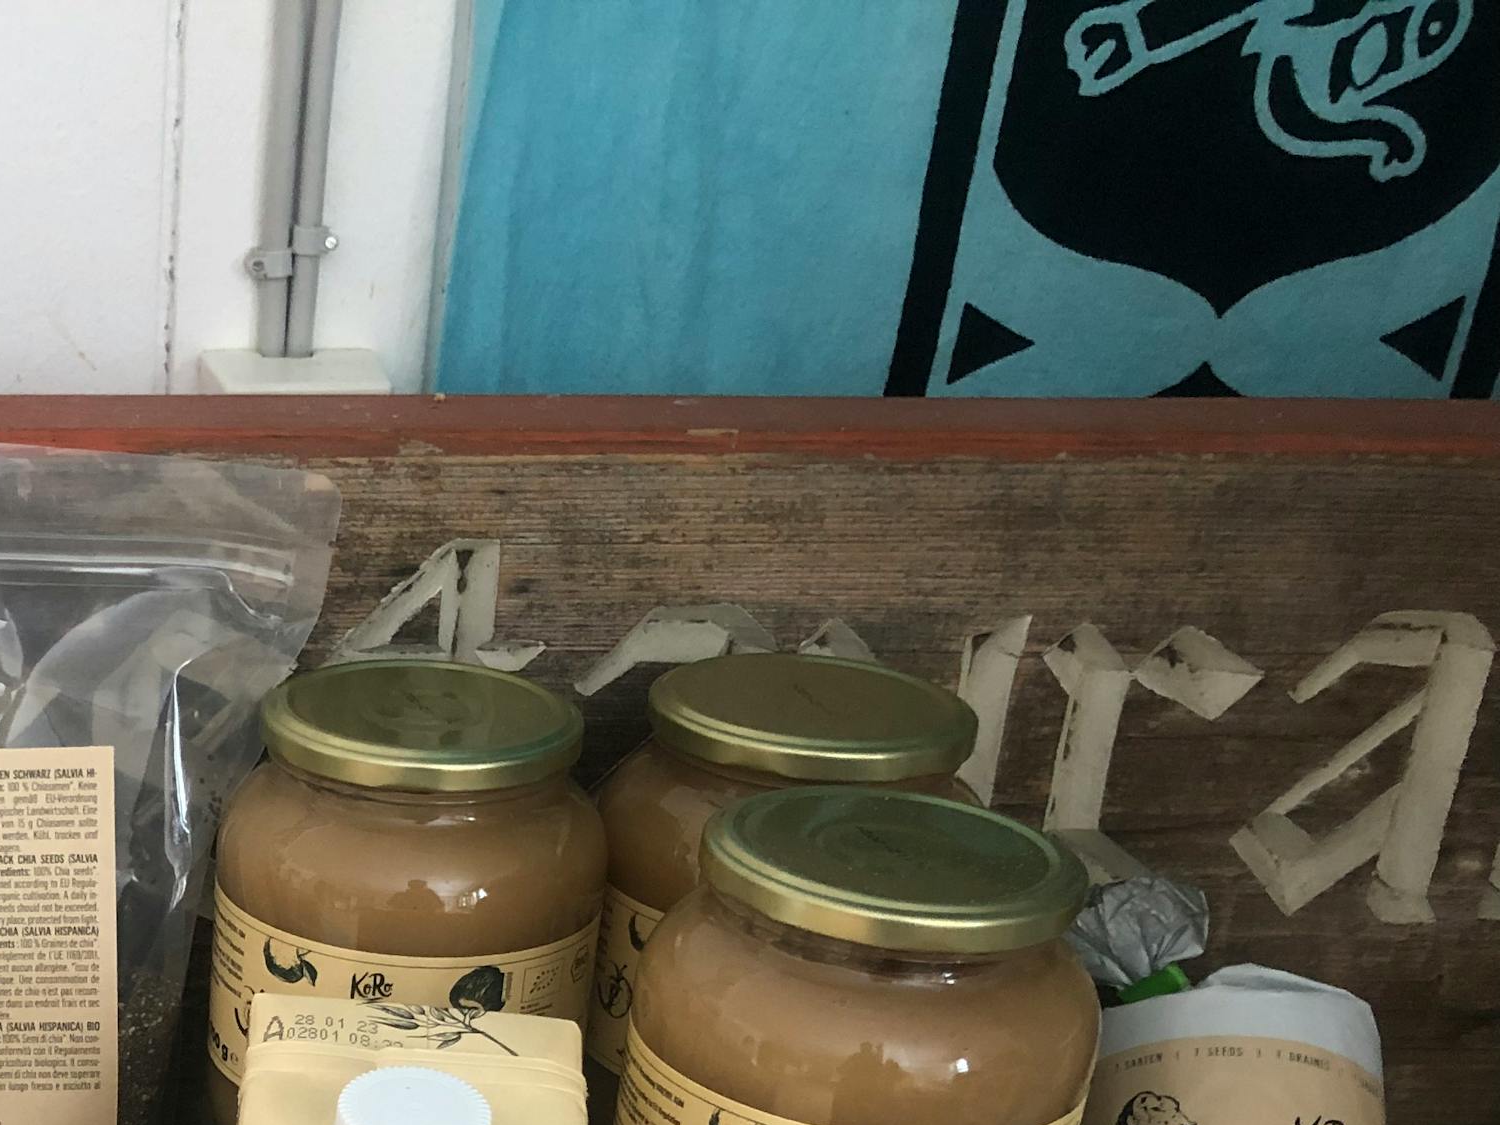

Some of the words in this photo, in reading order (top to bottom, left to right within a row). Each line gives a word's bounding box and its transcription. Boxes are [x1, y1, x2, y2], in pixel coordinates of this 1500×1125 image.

[349, 972, 395, 1000] KoRo
[294, 1014, 315, 1025] 28
[324, 1016, 346, 1028] 01
[357, 1020, 379, 1034] 23
[285, 1027, 340, 1043] 02801
[221, 1044, 228, 1062] g
